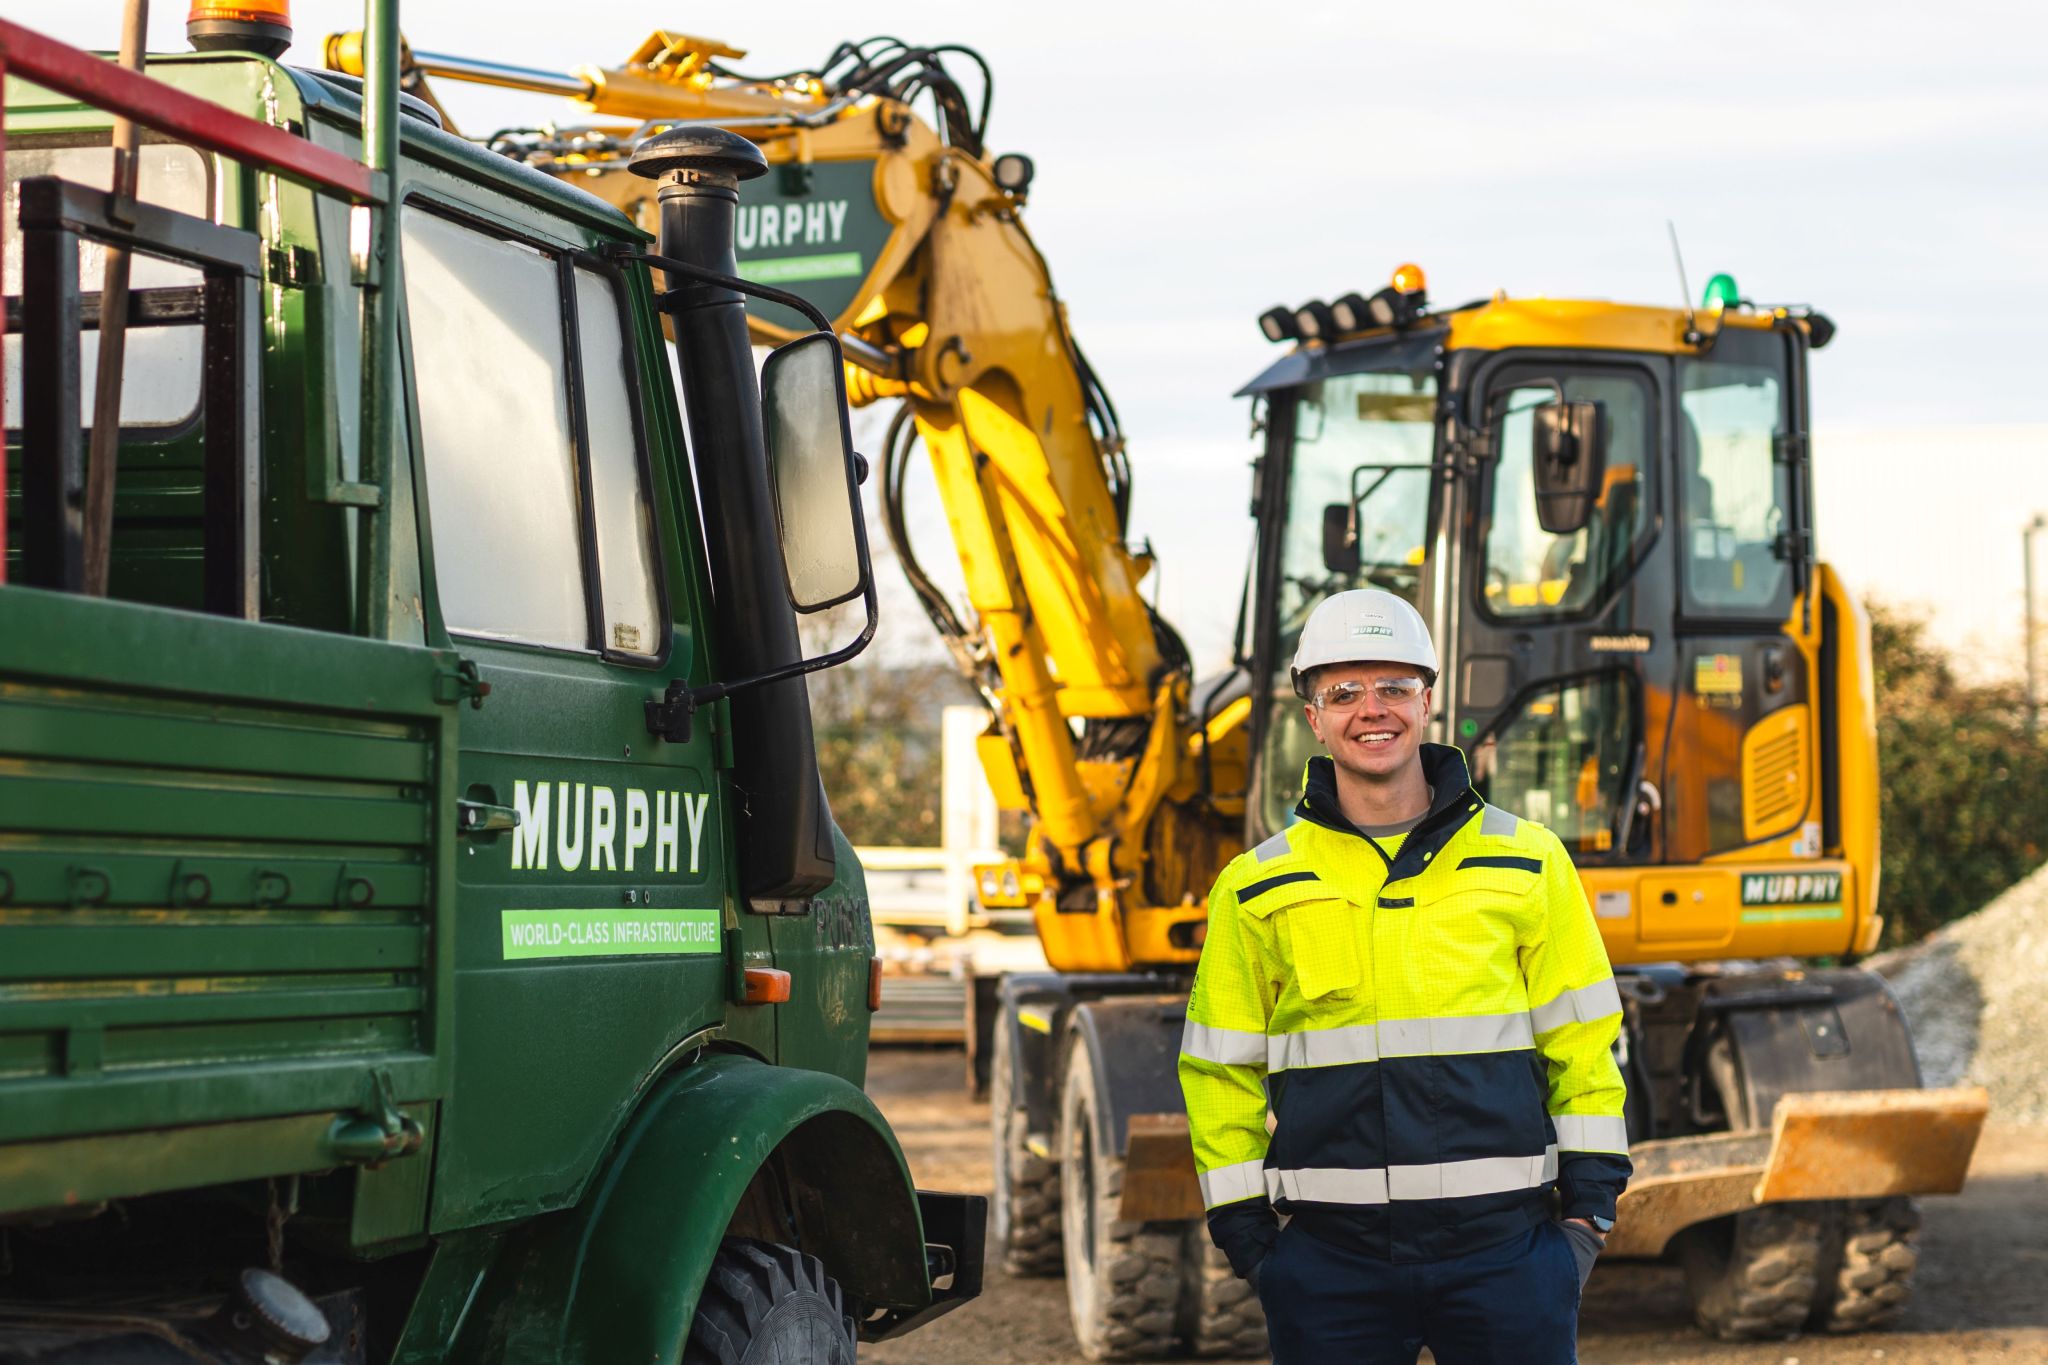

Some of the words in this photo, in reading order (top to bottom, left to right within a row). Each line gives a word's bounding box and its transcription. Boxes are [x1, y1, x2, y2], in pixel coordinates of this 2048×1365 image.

[737, 200, 848, 250] URPHY
[511, 780, 710, 873] MURPHY
[1743, 874, 1840, 903] MURPHY
[510, 922, 609, 946] WORLD-CLASS
[613, 921, 716, 943] INFRASTRUCTURE
